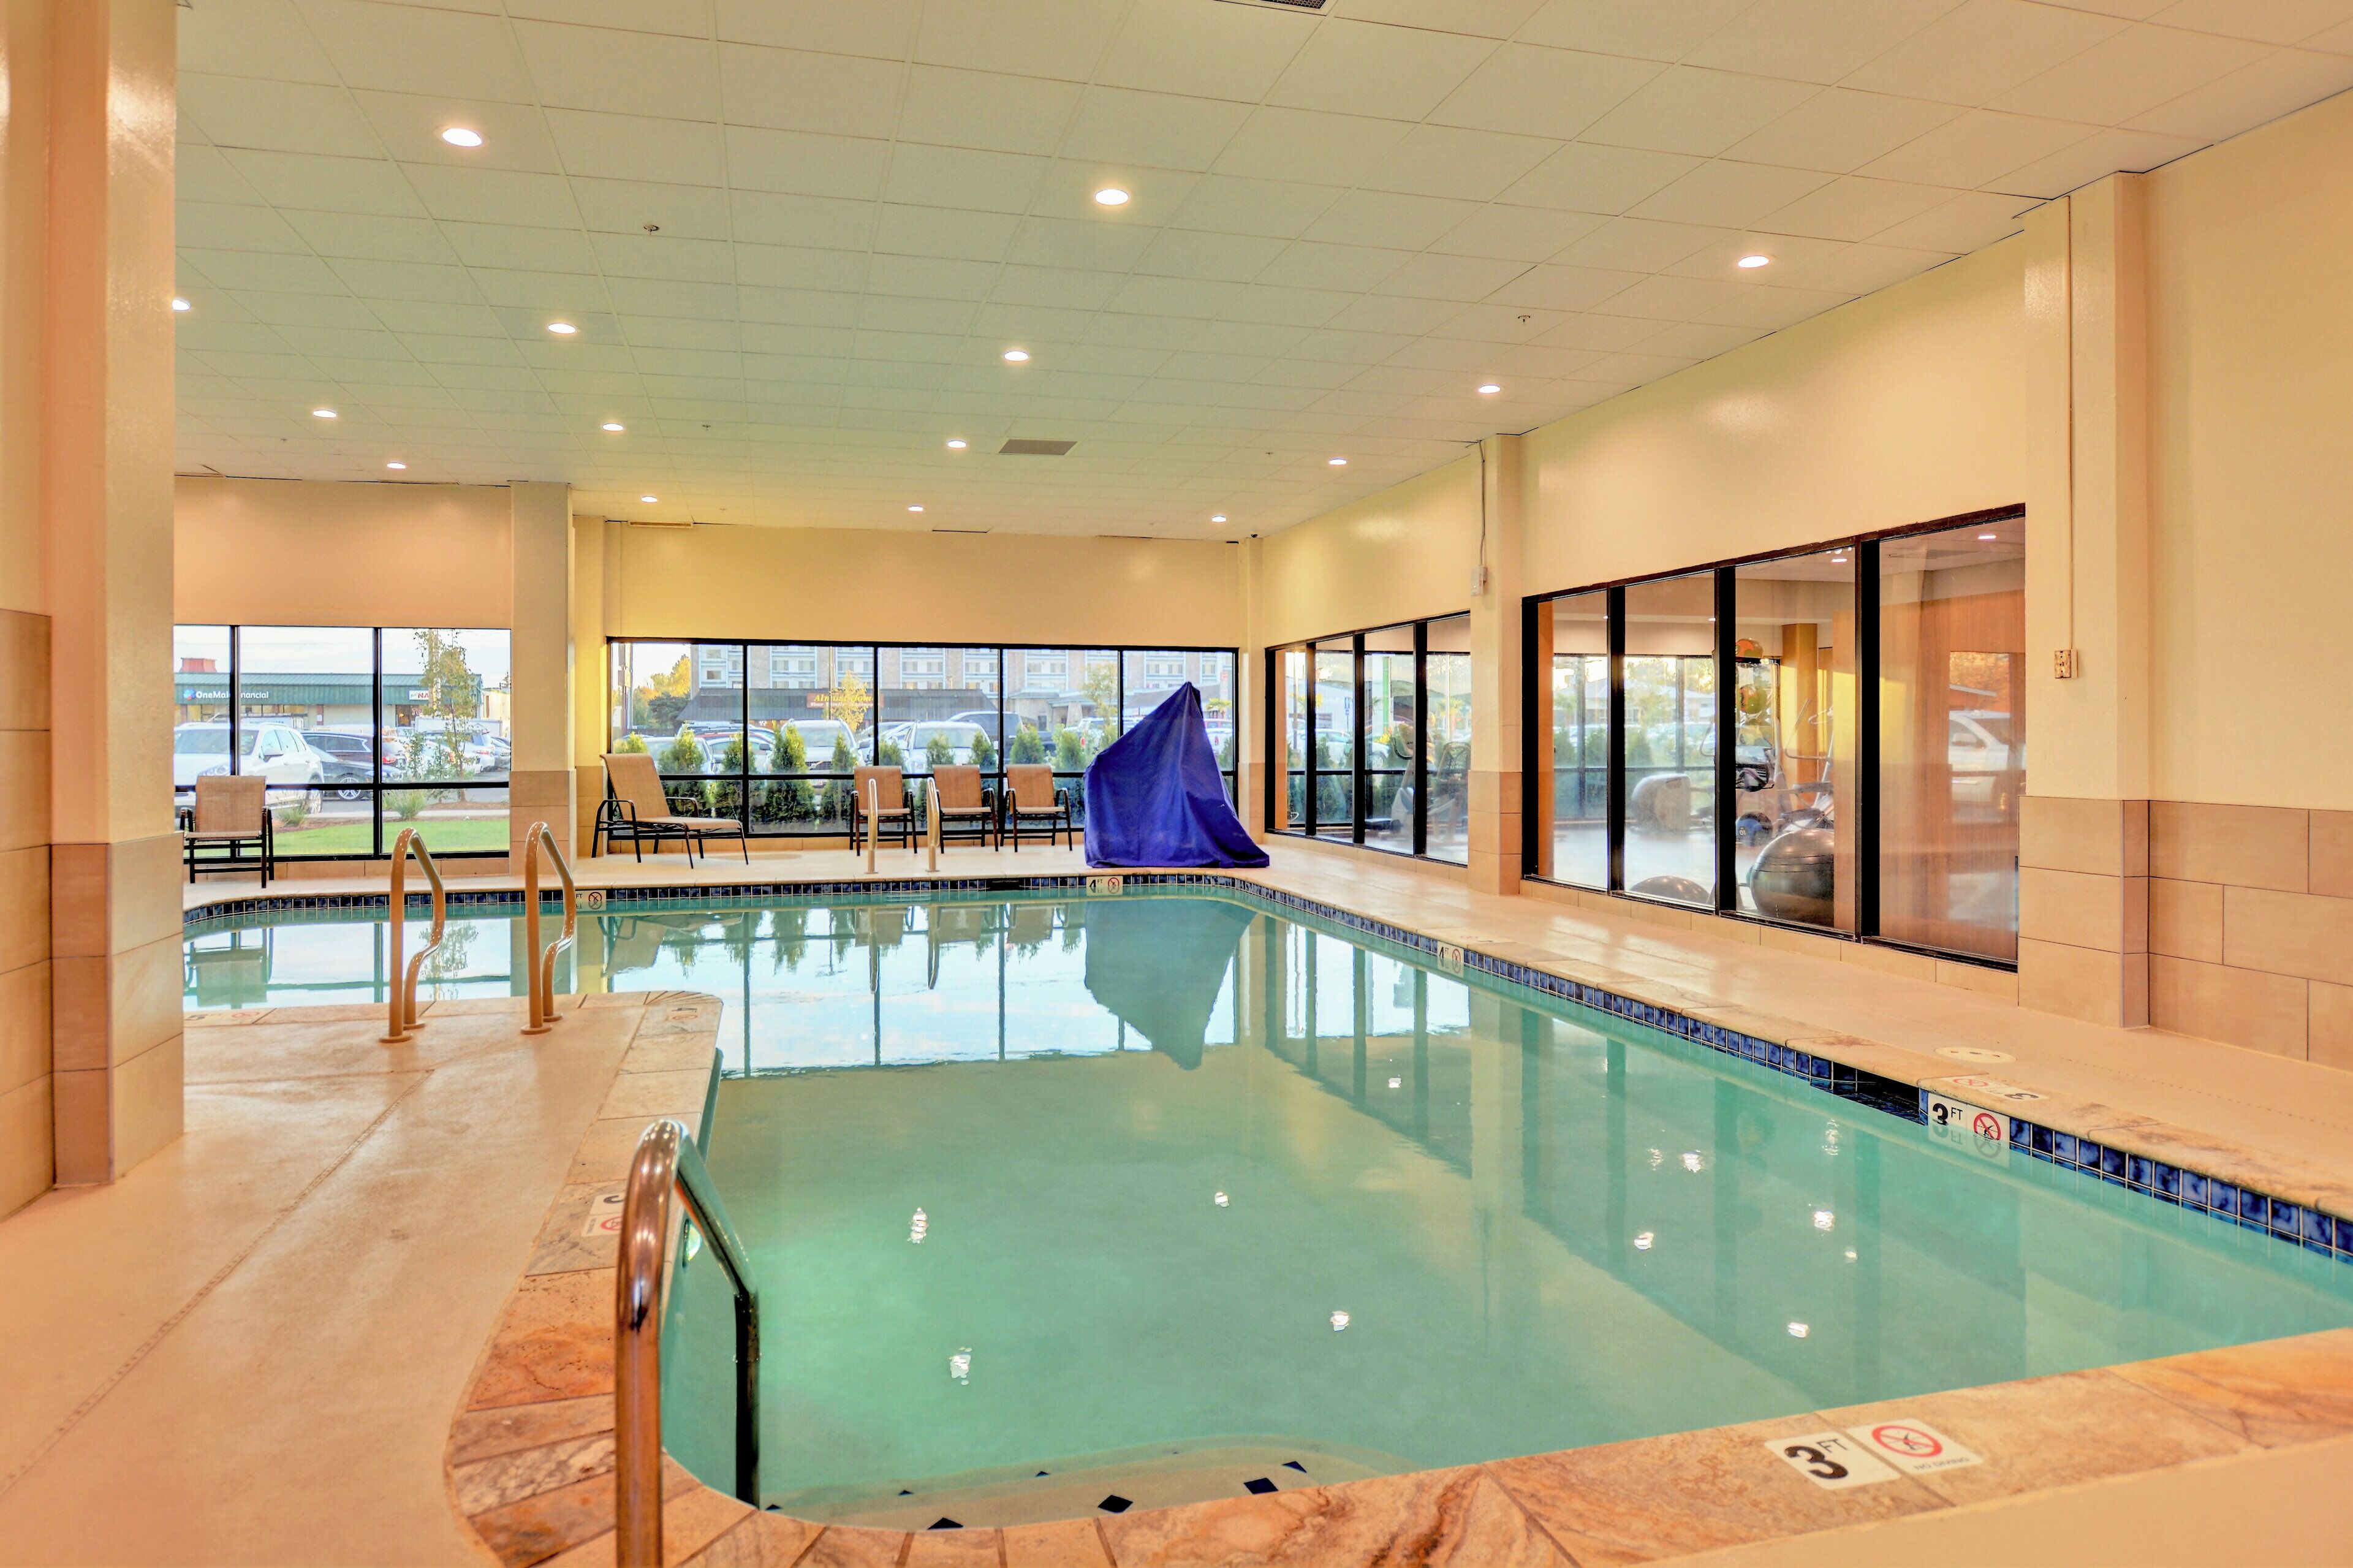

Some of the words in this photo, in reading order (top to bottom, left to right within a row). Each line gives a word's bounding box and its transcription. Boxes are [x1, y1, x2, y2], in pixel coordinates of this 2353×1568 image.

[1933, 1103, 1949, 1125] 3
[1951, 1107, 1963, 1120] FT
[1784, 1445, 1848, 1479] 3
[1816, 1439, 1848, 1453] FT
[1932, 1456, 1969, 1468] DIVING
